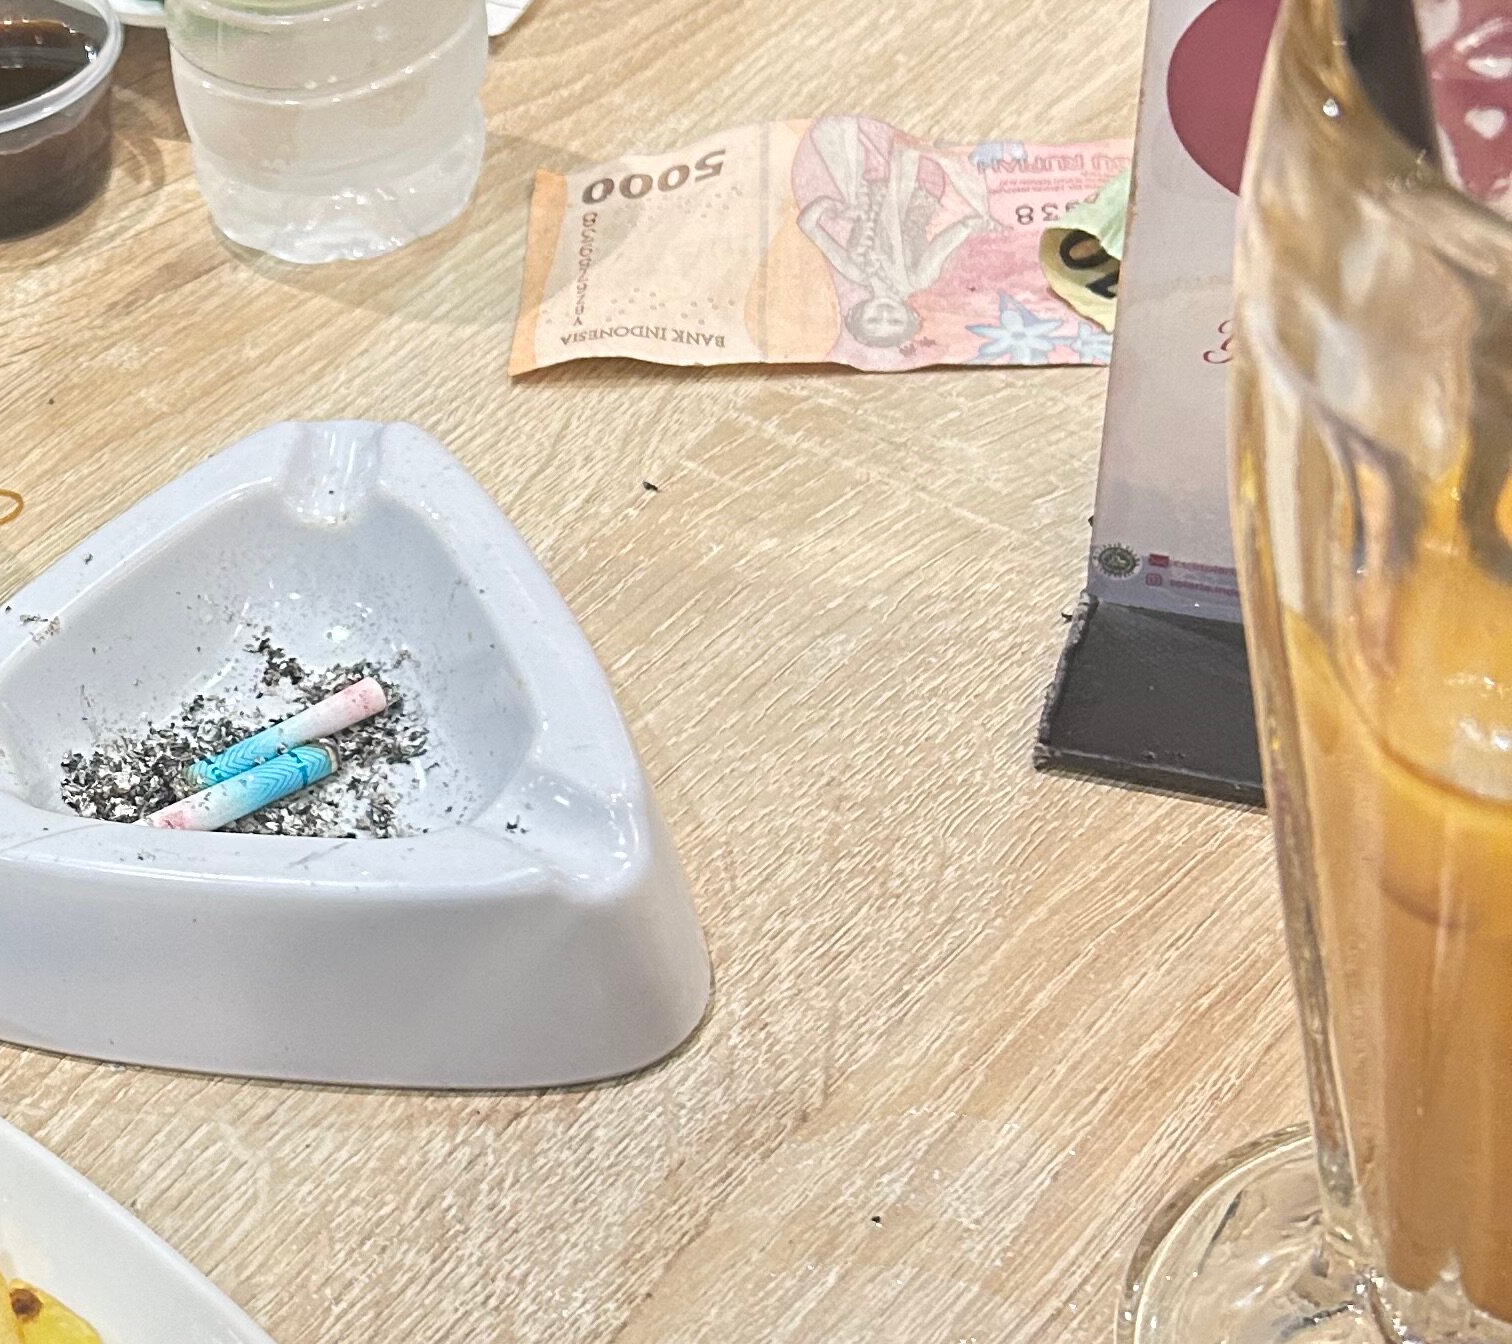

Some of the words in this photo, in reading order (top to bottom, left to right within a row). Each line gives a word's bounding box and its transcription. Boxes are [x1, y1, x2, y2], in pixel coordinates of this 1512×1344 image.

[583, 150, 726, 204] 5000
[560, 324, 667, 347] INDONESIA
[670, 329, 726, 348] BANK
